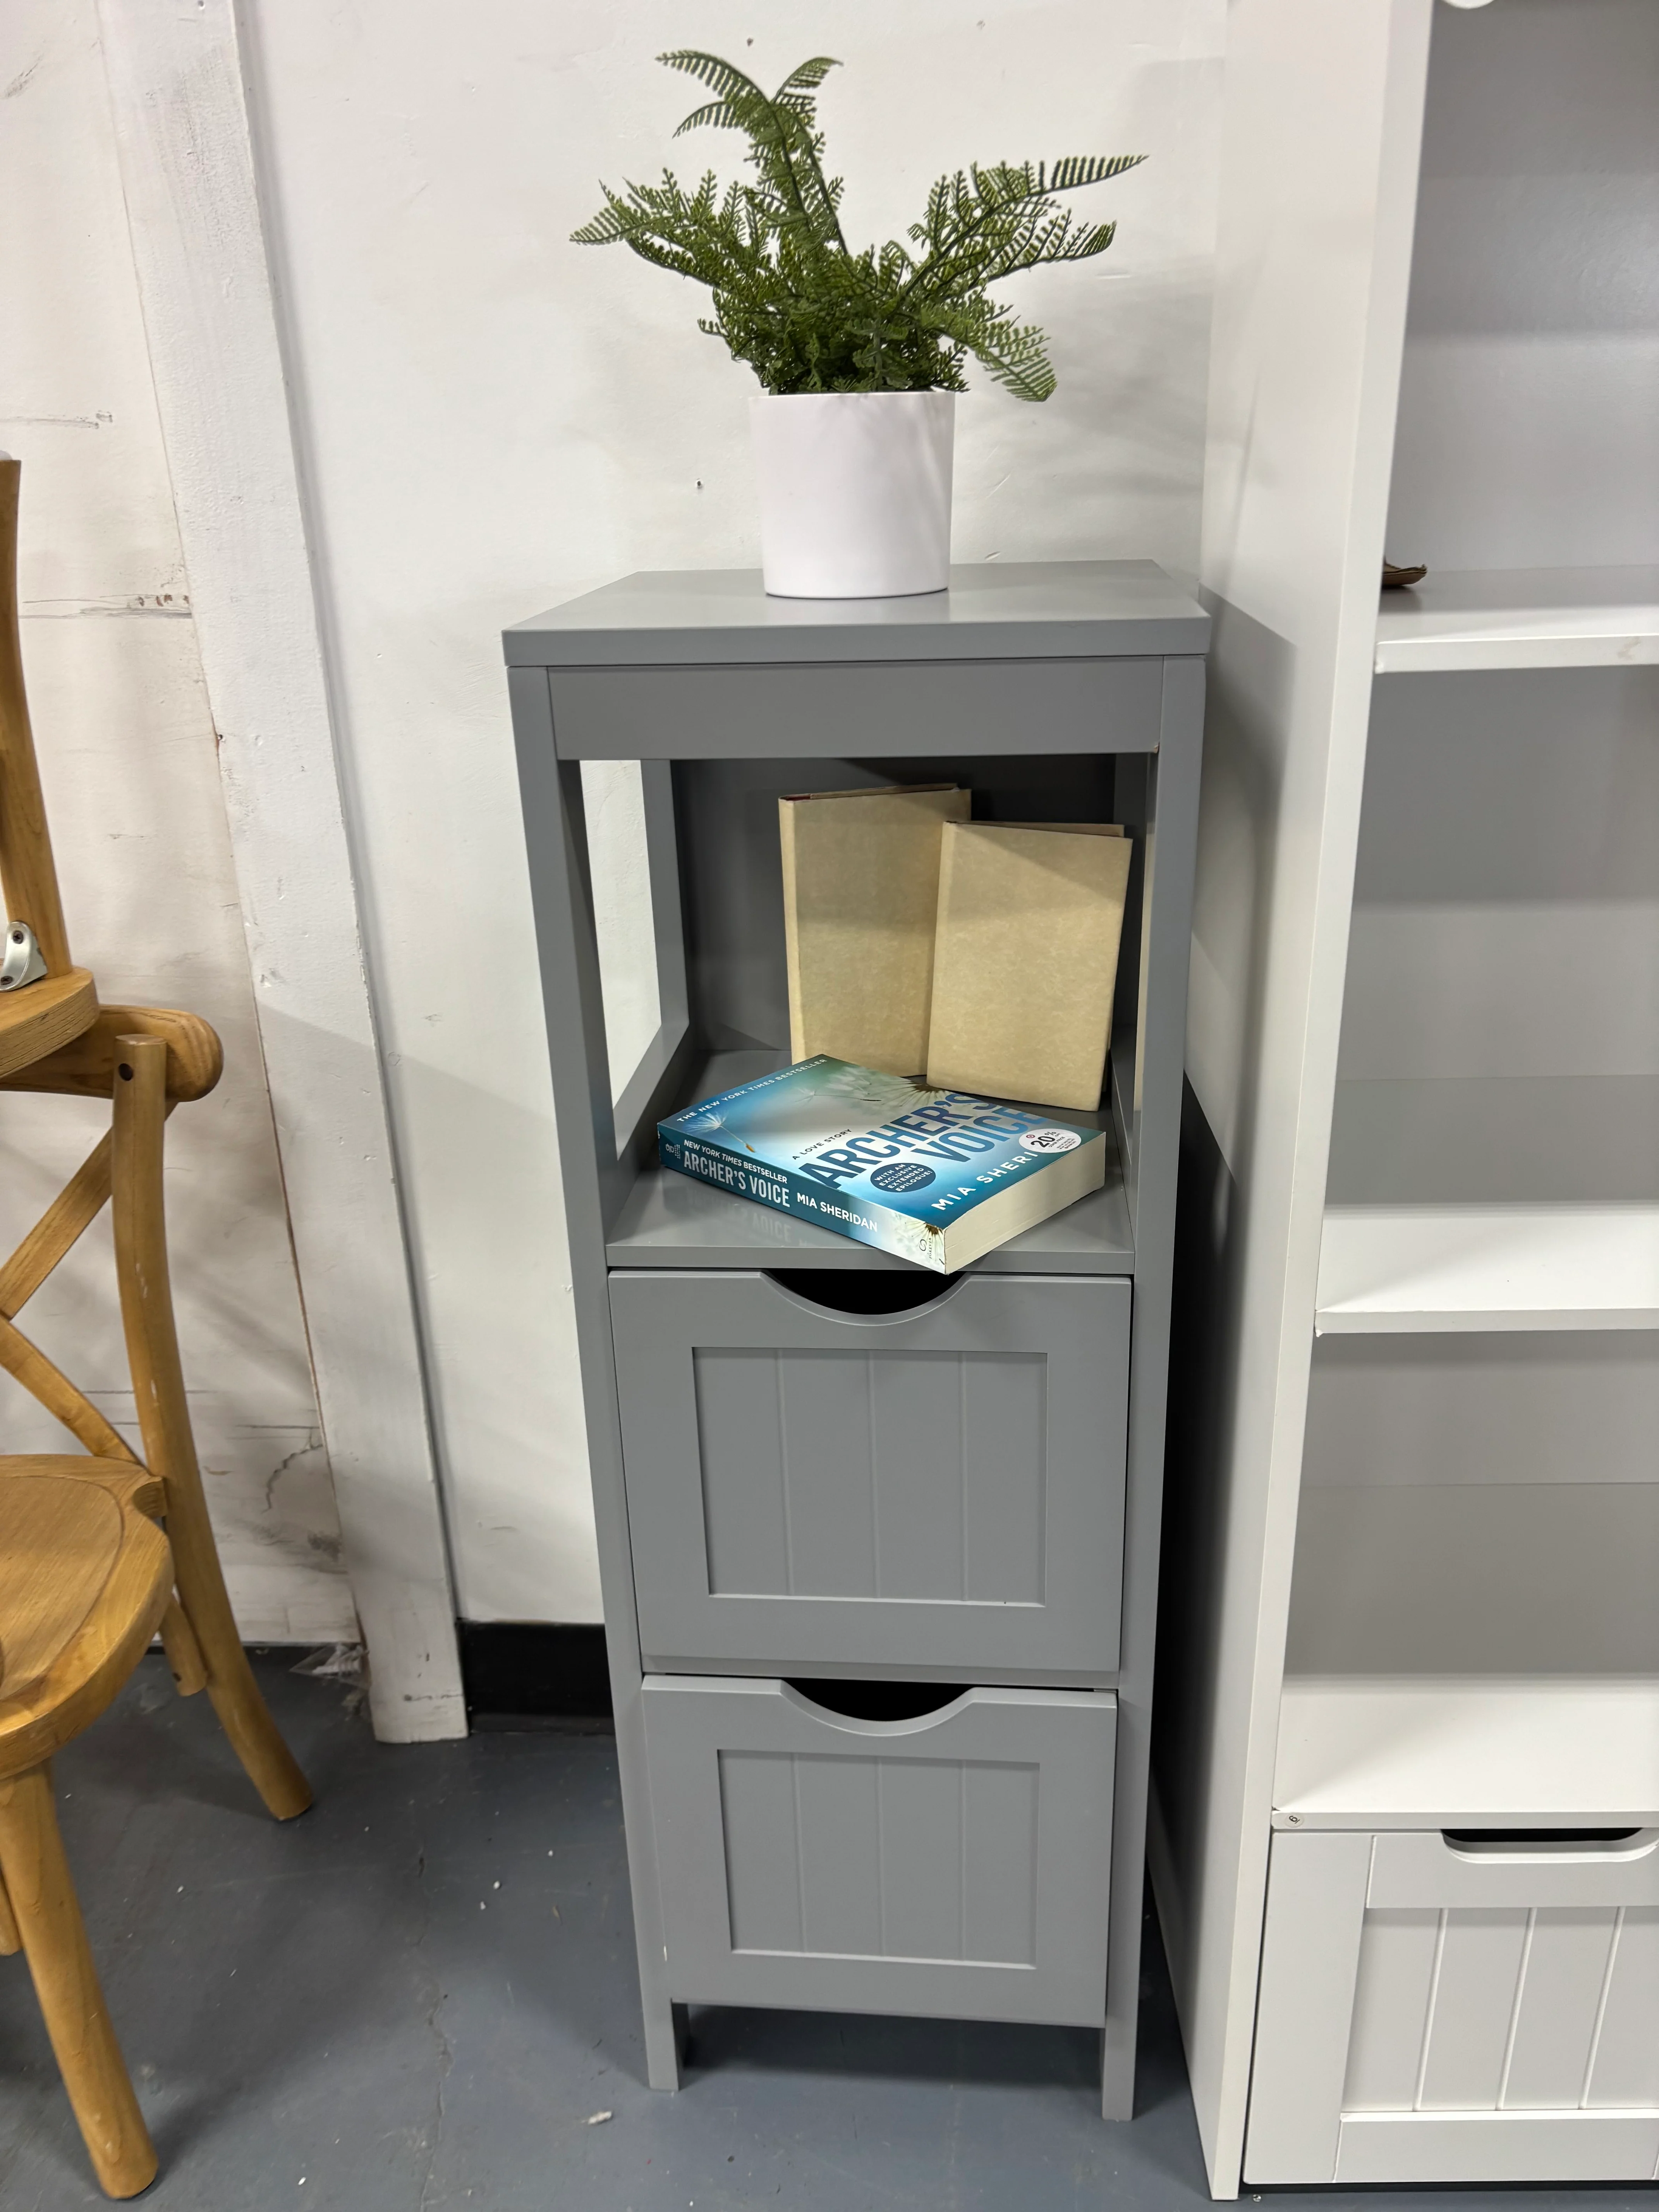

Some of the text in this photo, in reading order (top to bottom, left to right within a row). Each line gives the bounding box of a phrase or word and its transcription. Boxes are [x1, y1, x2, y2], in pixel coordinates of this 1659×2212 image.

[677, 1059, 827, 1122] THE NEW YORK TIMES BESTSELLER
[799, 1094, 997, 1188] ARCHER'S
[799, 1142, 824, 1155] LOVE
[824, 1128, 852, 1142] STORY
[910, 1107, 1048, 1162] VOICE
[1030, 1132, 1056, 1148] 20%
[684, 1139, 787, 1184] NEW YORK TIMES BESTSELLER
[684, 1151, 746, 1190] ARCHER'S
[749, 1175, 790, 1207] VOICE
[874, 1170, 895, 1181] WITH
[879, 1165, 917, 1186] EXCLUSIVE
[887, 1168, 924, 1188] EXTENDED
[895, 1170, 933, 1191] EPILOGUE!
[931, 1151, 1038, 1210] MIA SHERI
[797, 1192, 878, 1232] MIA SHERIDAN
